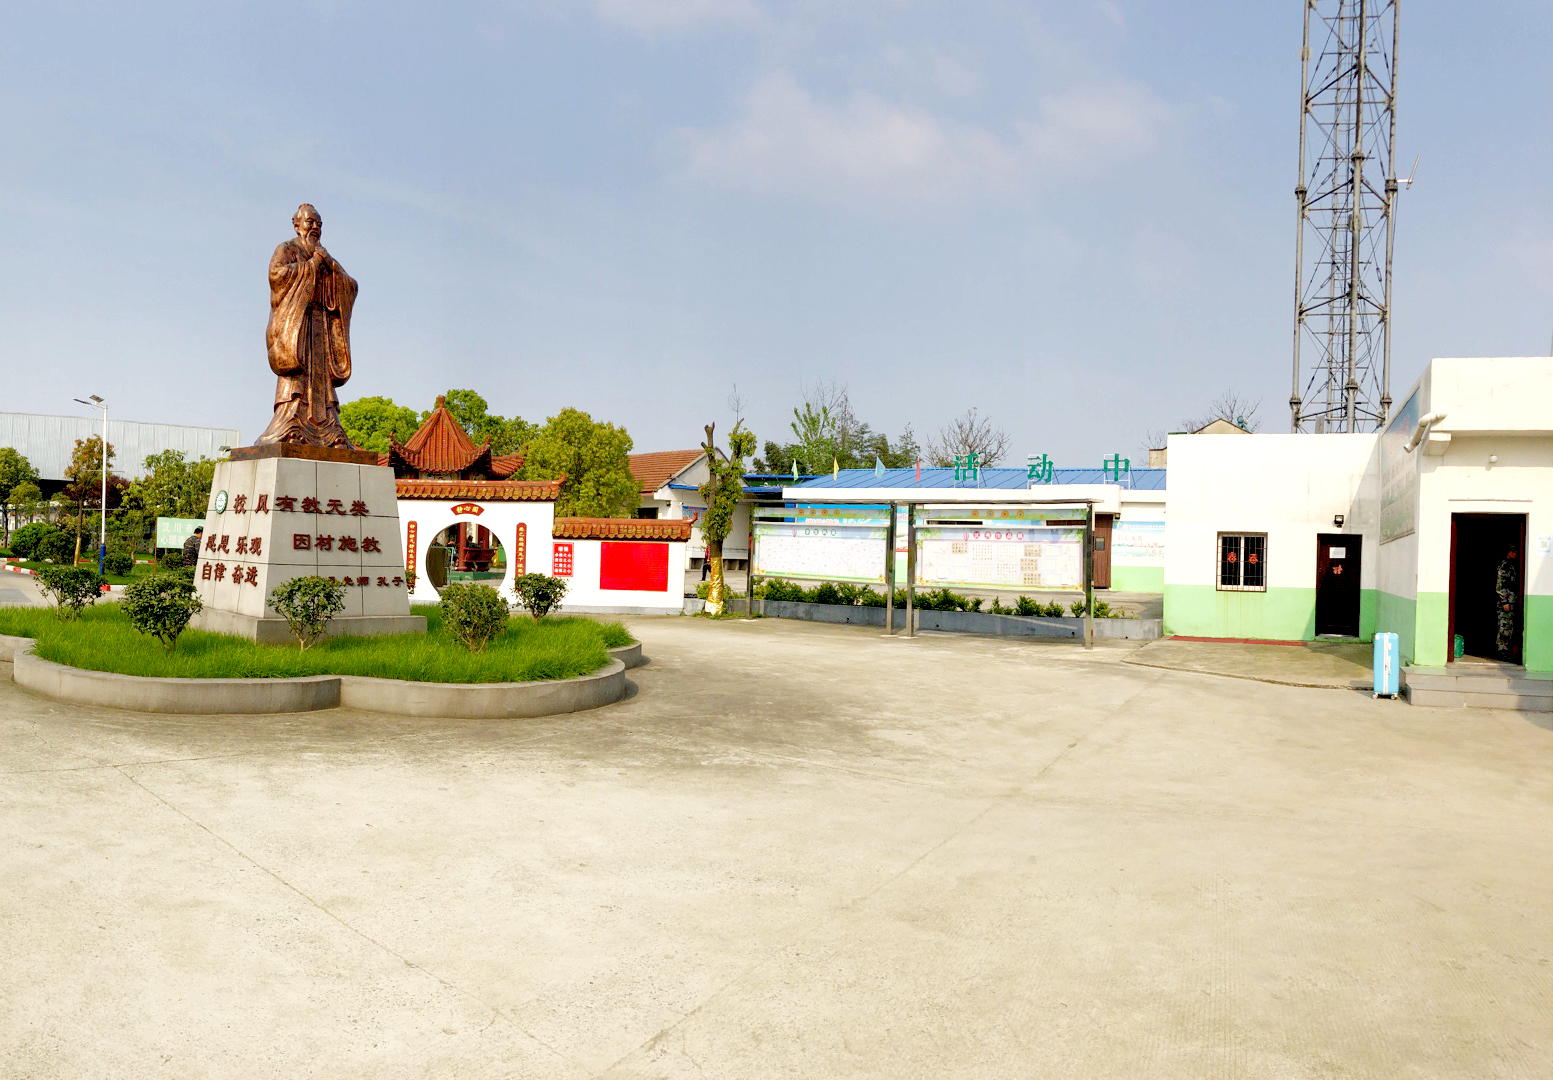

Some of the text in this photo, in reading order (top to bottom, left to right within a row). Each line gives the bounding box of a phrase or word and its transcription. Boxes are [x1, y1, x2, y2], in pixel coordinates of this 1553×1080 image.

[954, 453, 1130, 483] 活动中
[233, 494, 269, 514] 校风
[275, 495, 369, 516] 有教无类
[205, 534, 262, 556] 感恩 乐观
[293, 534, 381, 552] 因材施教
[202, 561, 258, 587] 自律 奋进
[376, 576, 404, 587] 孔子
